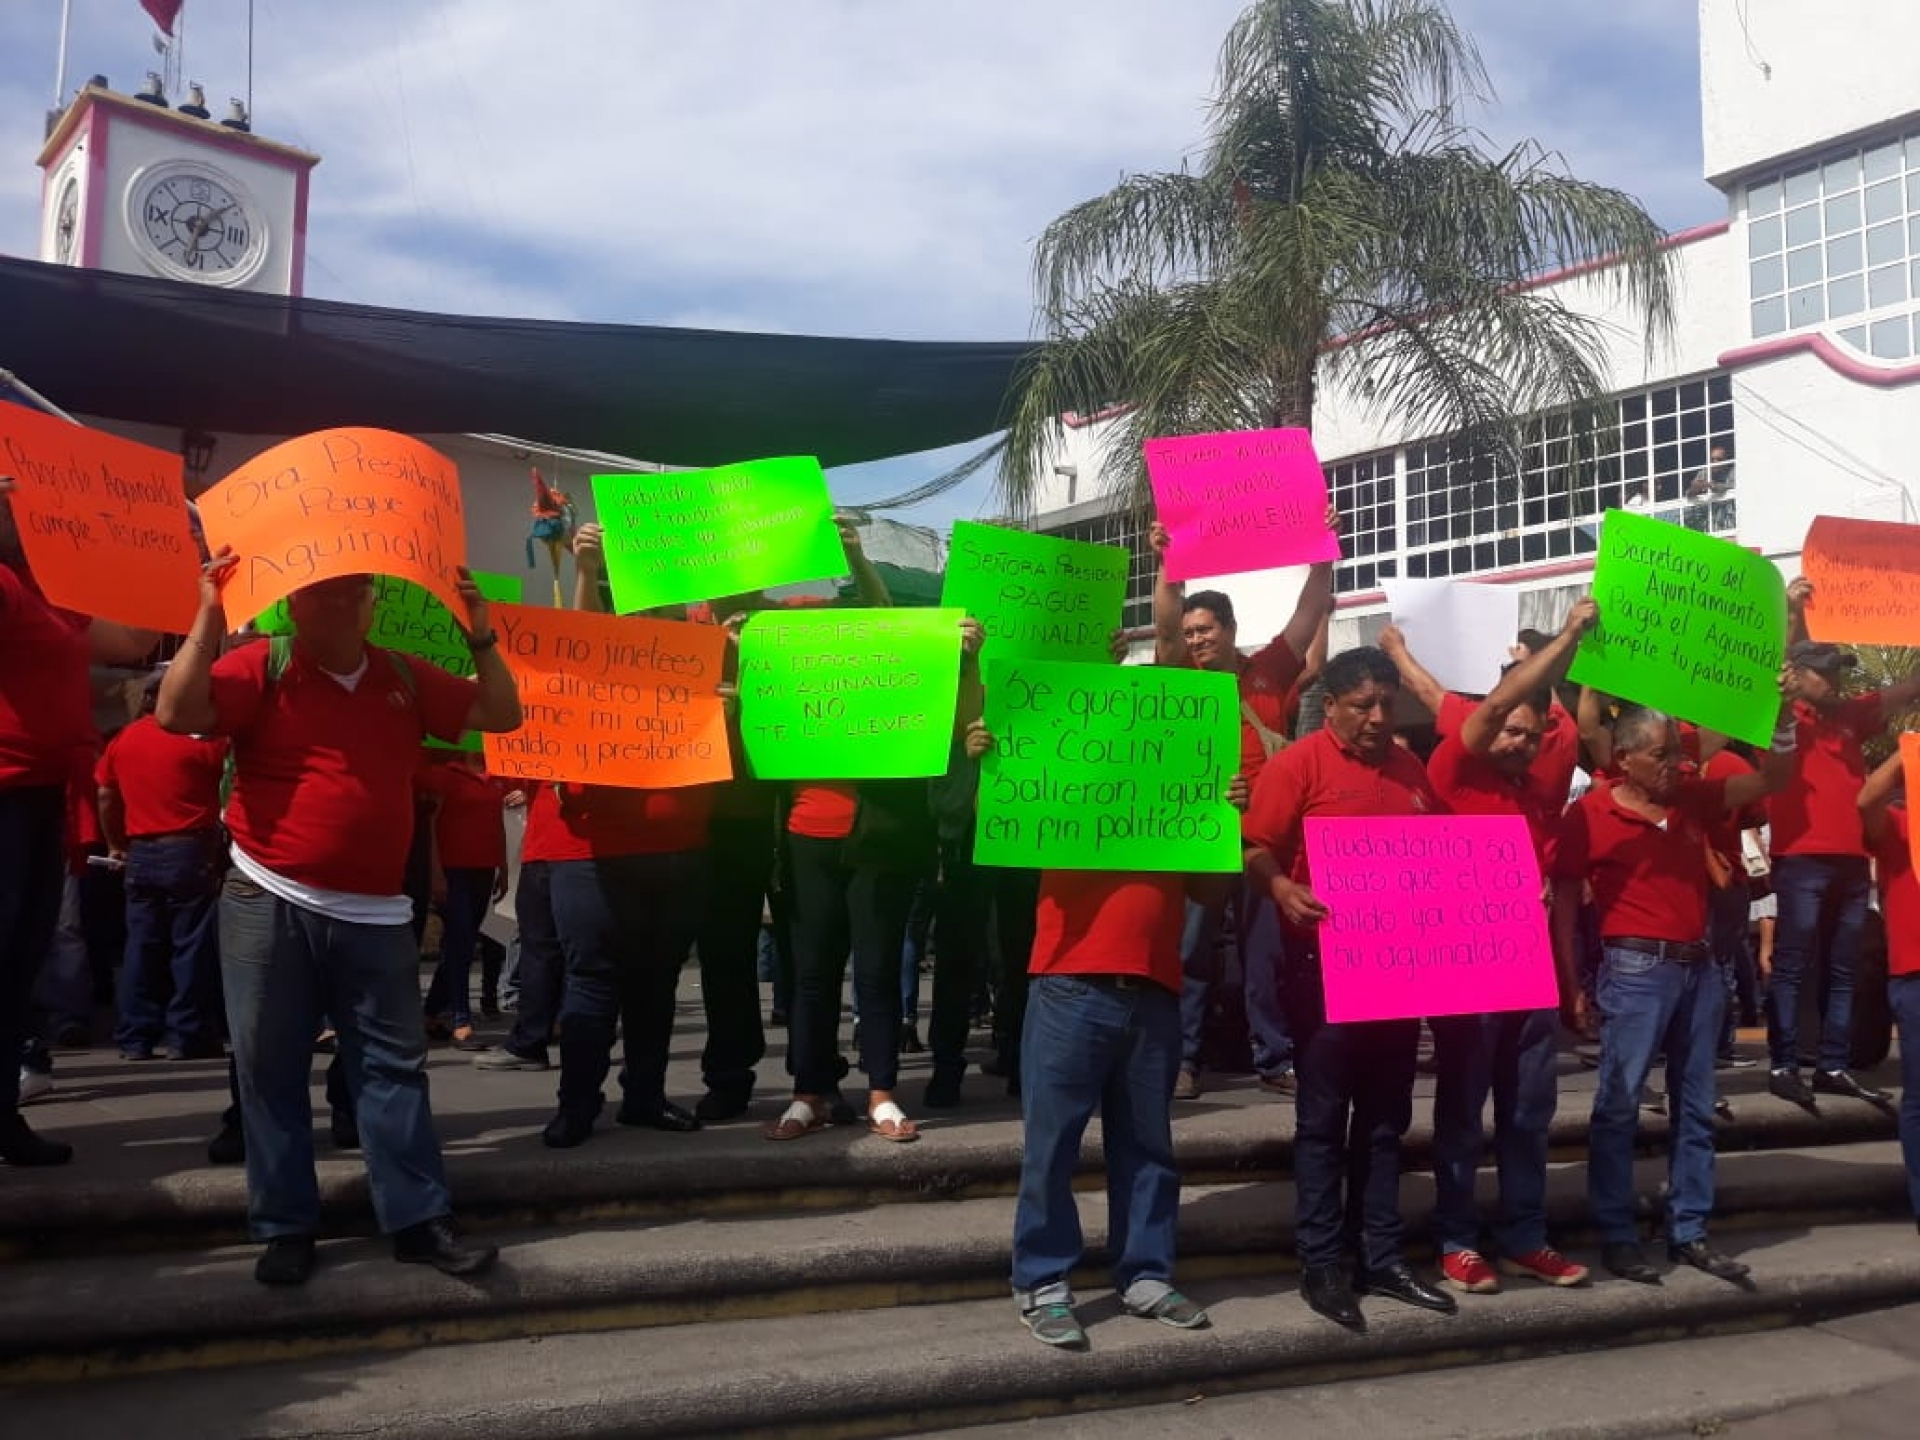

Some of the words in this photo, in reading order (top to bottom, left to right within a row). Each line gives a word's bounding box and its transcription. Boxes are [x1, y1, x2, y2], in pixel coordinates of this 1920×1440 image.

[300, 487, 403, 517] Pague
[1721, 565, 1746, 592] del
[998, 584, 1092, 613] PAGUE
[1645, 570, 1766, 630] Ayuntamiento
[971, 612, 1104, 645] GUINALDO
[1669, 609, 1691, 636] el
[501, 614, 539, 656] Ya
[555, 635, 592, 663] no
[602, 635, 706, 678] jinetees
[1670, 643, 1689, 671] tu
[1690, 658, 1754, 692] palabra
[546, 668, 641, 703] dinero
[756, 684, 784, 700] MI
[1006, 670, 1054, 712] Se
[1068, 681, 1220, 732] quejaban
[590, 706, 622, 731] mi
[803, 697, 846, 720] NO
[755, 724, 788, 743] TE
[496, 730, 561, 758] naldo
[575, 742, 589, 771] y
[996, 724, 1037, 760] de
[1192, 734, 1213, 778] y
[1160, 764, 1221, 821] igual
[985, 815, 1020, 843] en
[1457, 863, 1481, 891] el
[1330, 904, 1397, 934] bildo
[1410, 905, 1445, 938] ya
